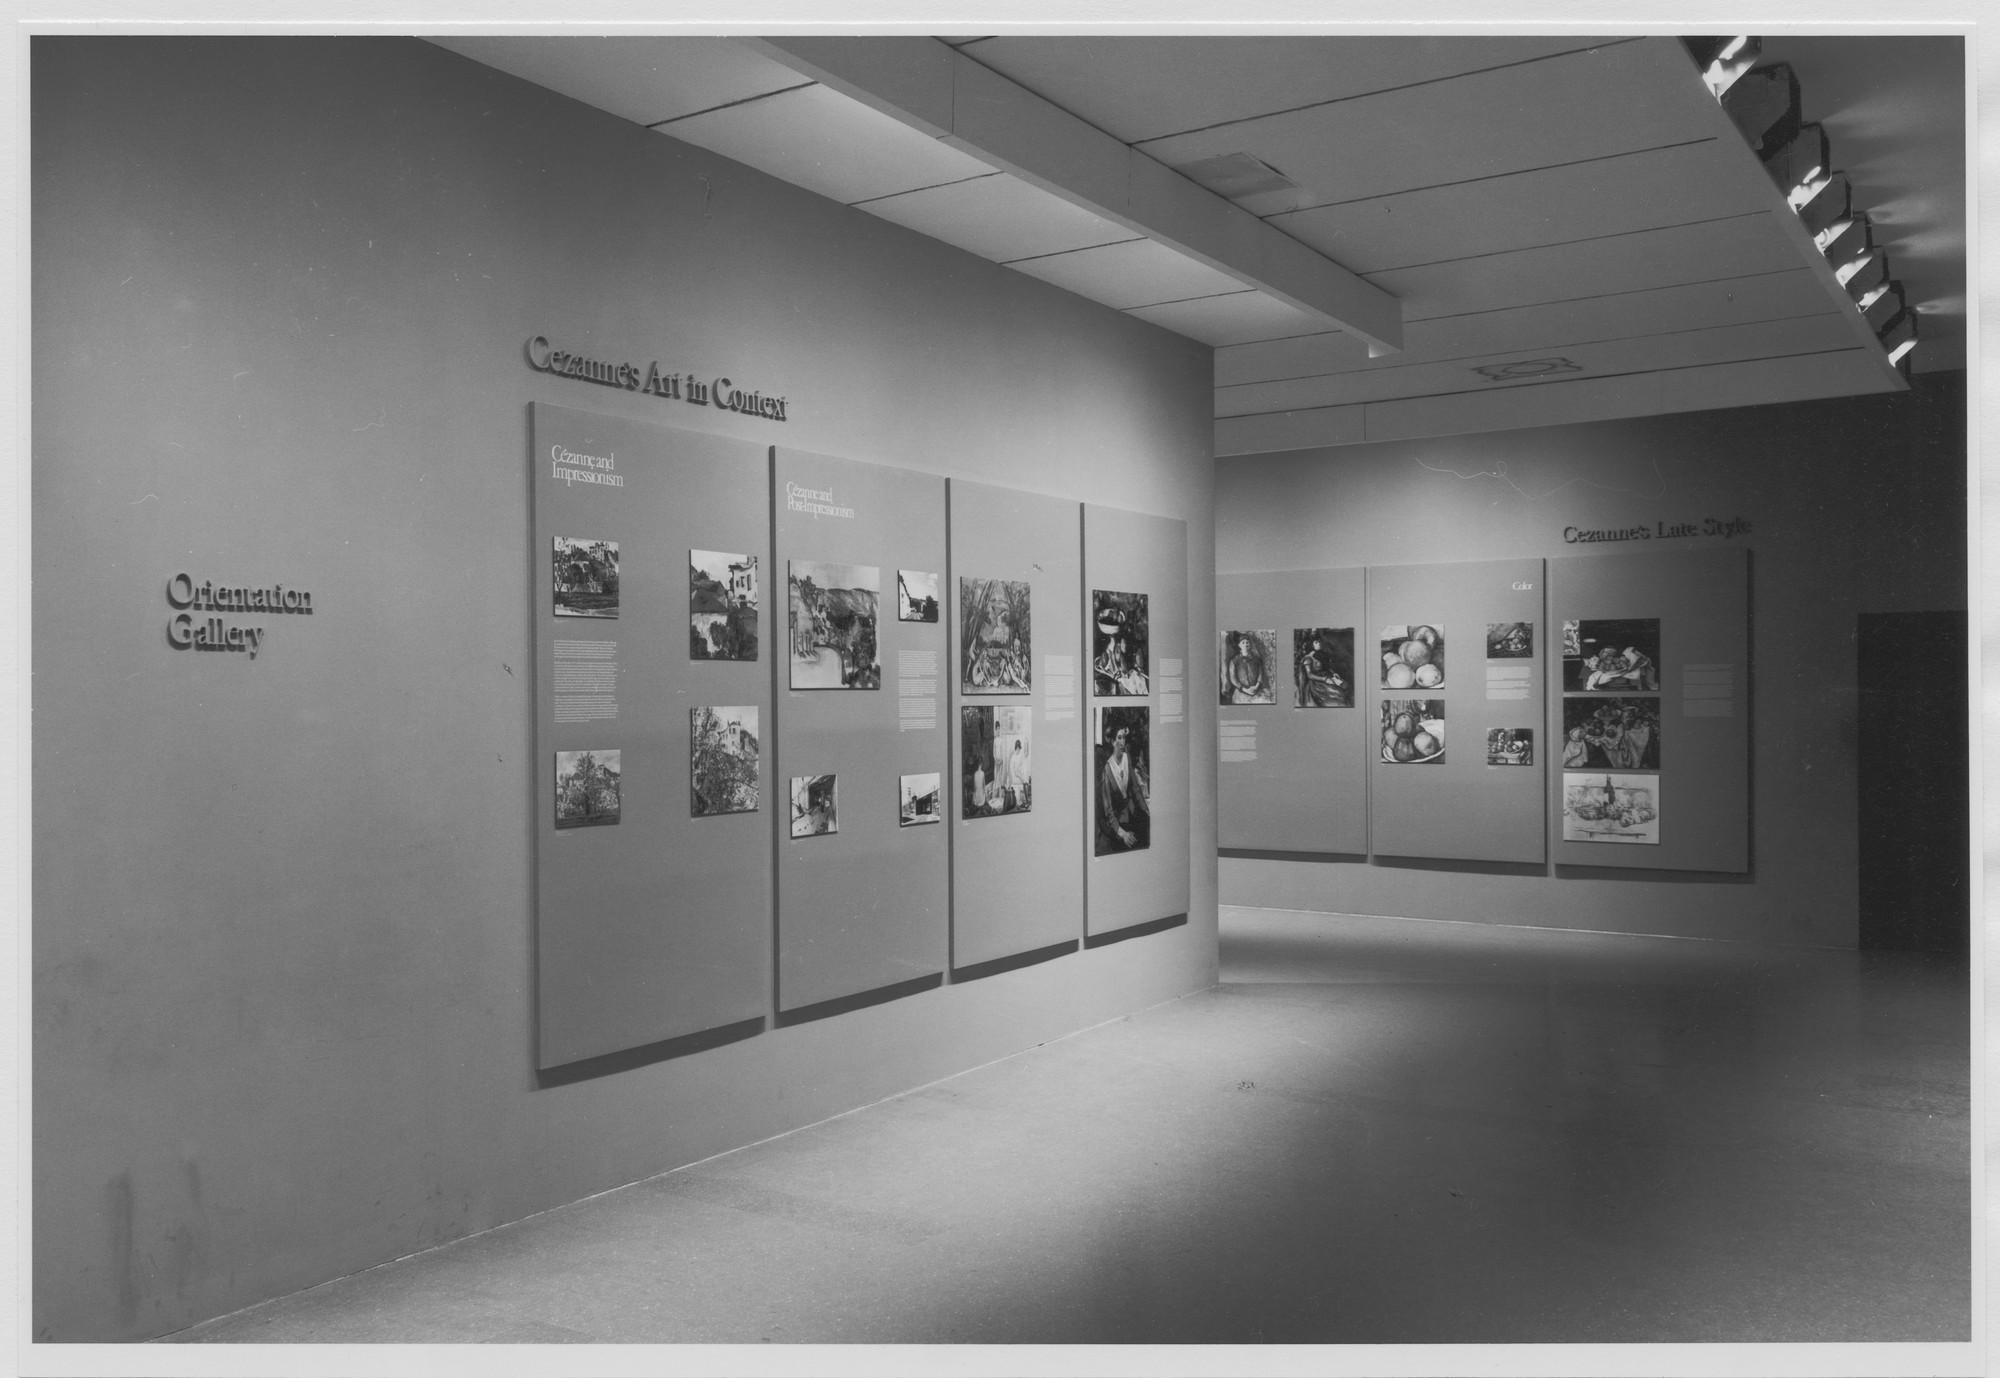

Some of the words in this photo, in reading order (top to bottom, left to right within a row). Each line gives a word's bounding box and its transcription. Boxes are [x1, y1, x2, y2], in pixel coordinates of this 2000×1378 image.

[642, 360, 683, 399] Art
[686, 375, 709, 405] in
[712, 377, 788, 421] Context
[551, 444, 595, 467] Cézanne
[595, 453, 614, 470] and
[552, 462, 623, 487] Impressionism
[786, 481, 819, 500] Cézanne
[819, 487, 832, 502] and
[1655, 522, 1698, 540] Late
[1704, 517, 1753, 540] Style
[166, 573, 313, 615] Orientation
[1512, 580, 1533, 591] Color
[166, 614, 264, 660] Gallery
